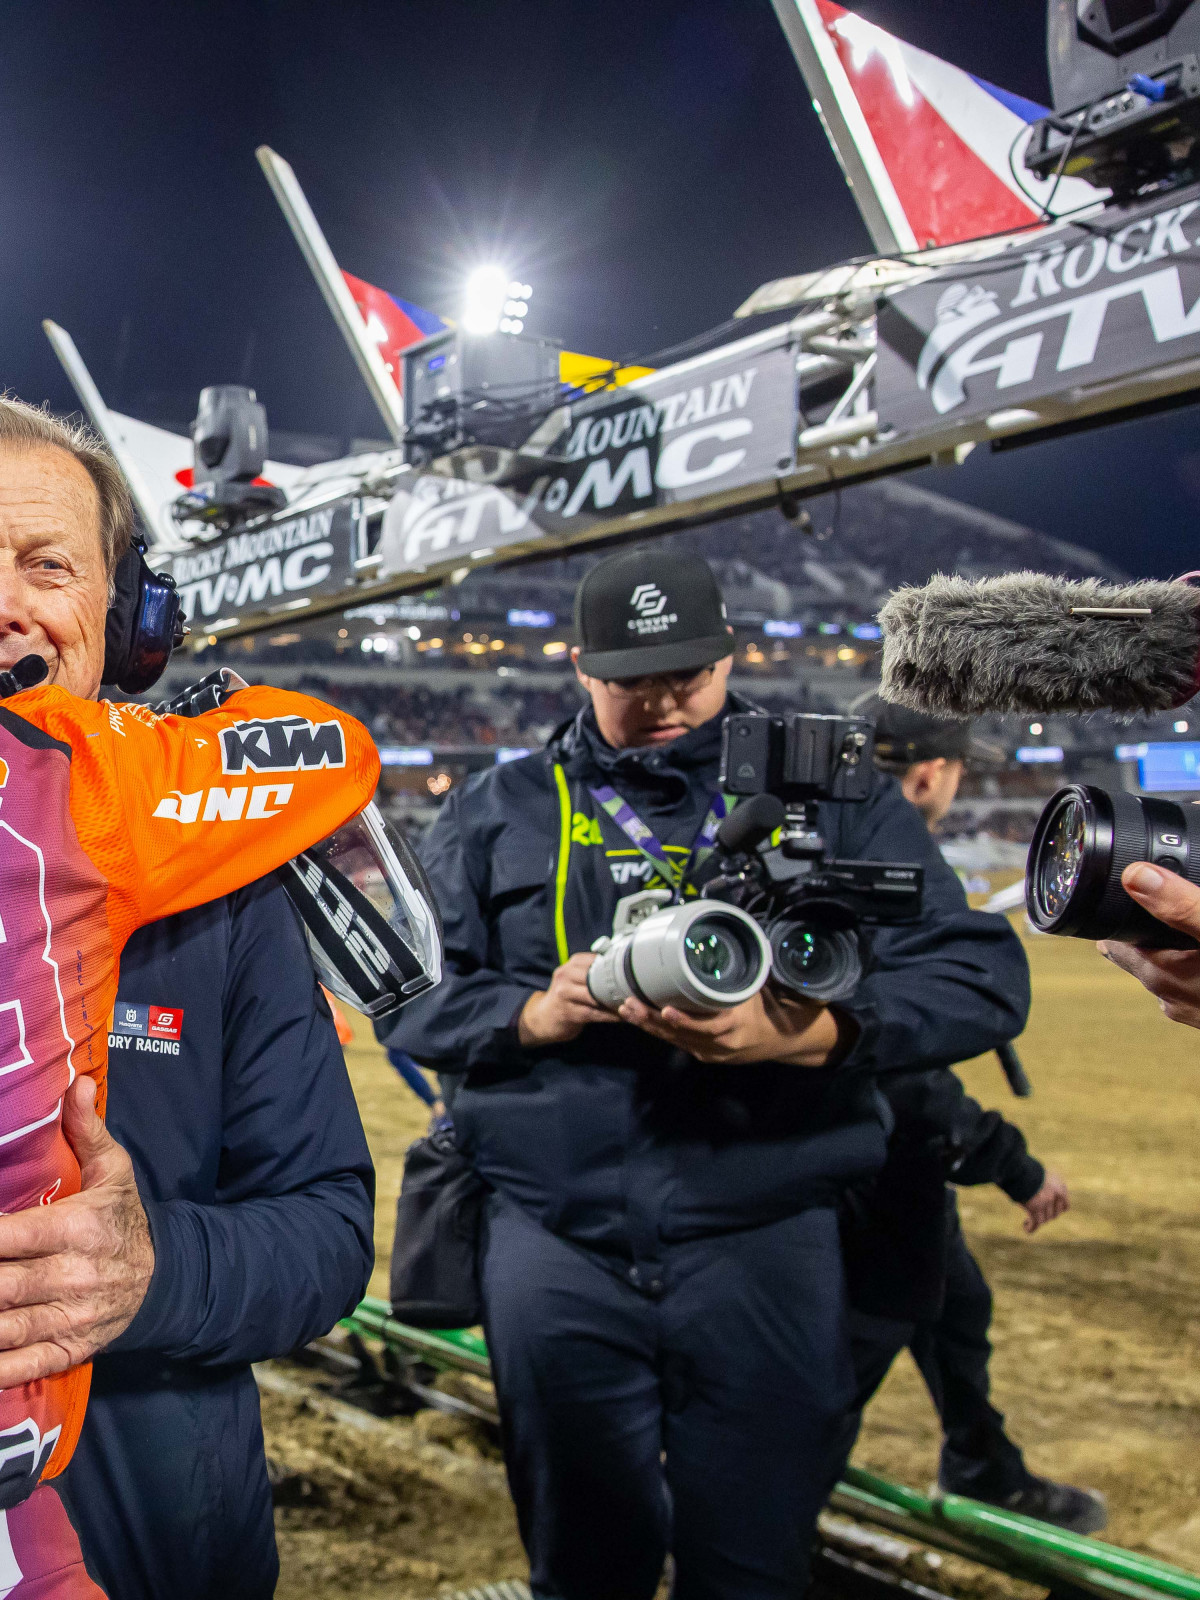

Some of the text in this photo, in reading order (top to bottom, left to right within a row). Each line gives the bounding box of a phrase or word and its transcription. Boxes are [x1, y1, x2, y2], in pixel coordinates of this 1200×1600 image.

[1010, 198, 1200, 308] ROCK
[567, 369, 759, 461] MOUNTAIN
[177, 572, 230, 623] TV
[218, 715, 347, 776] KTM
[108, 1034, 180, 1056] ORY RACING
